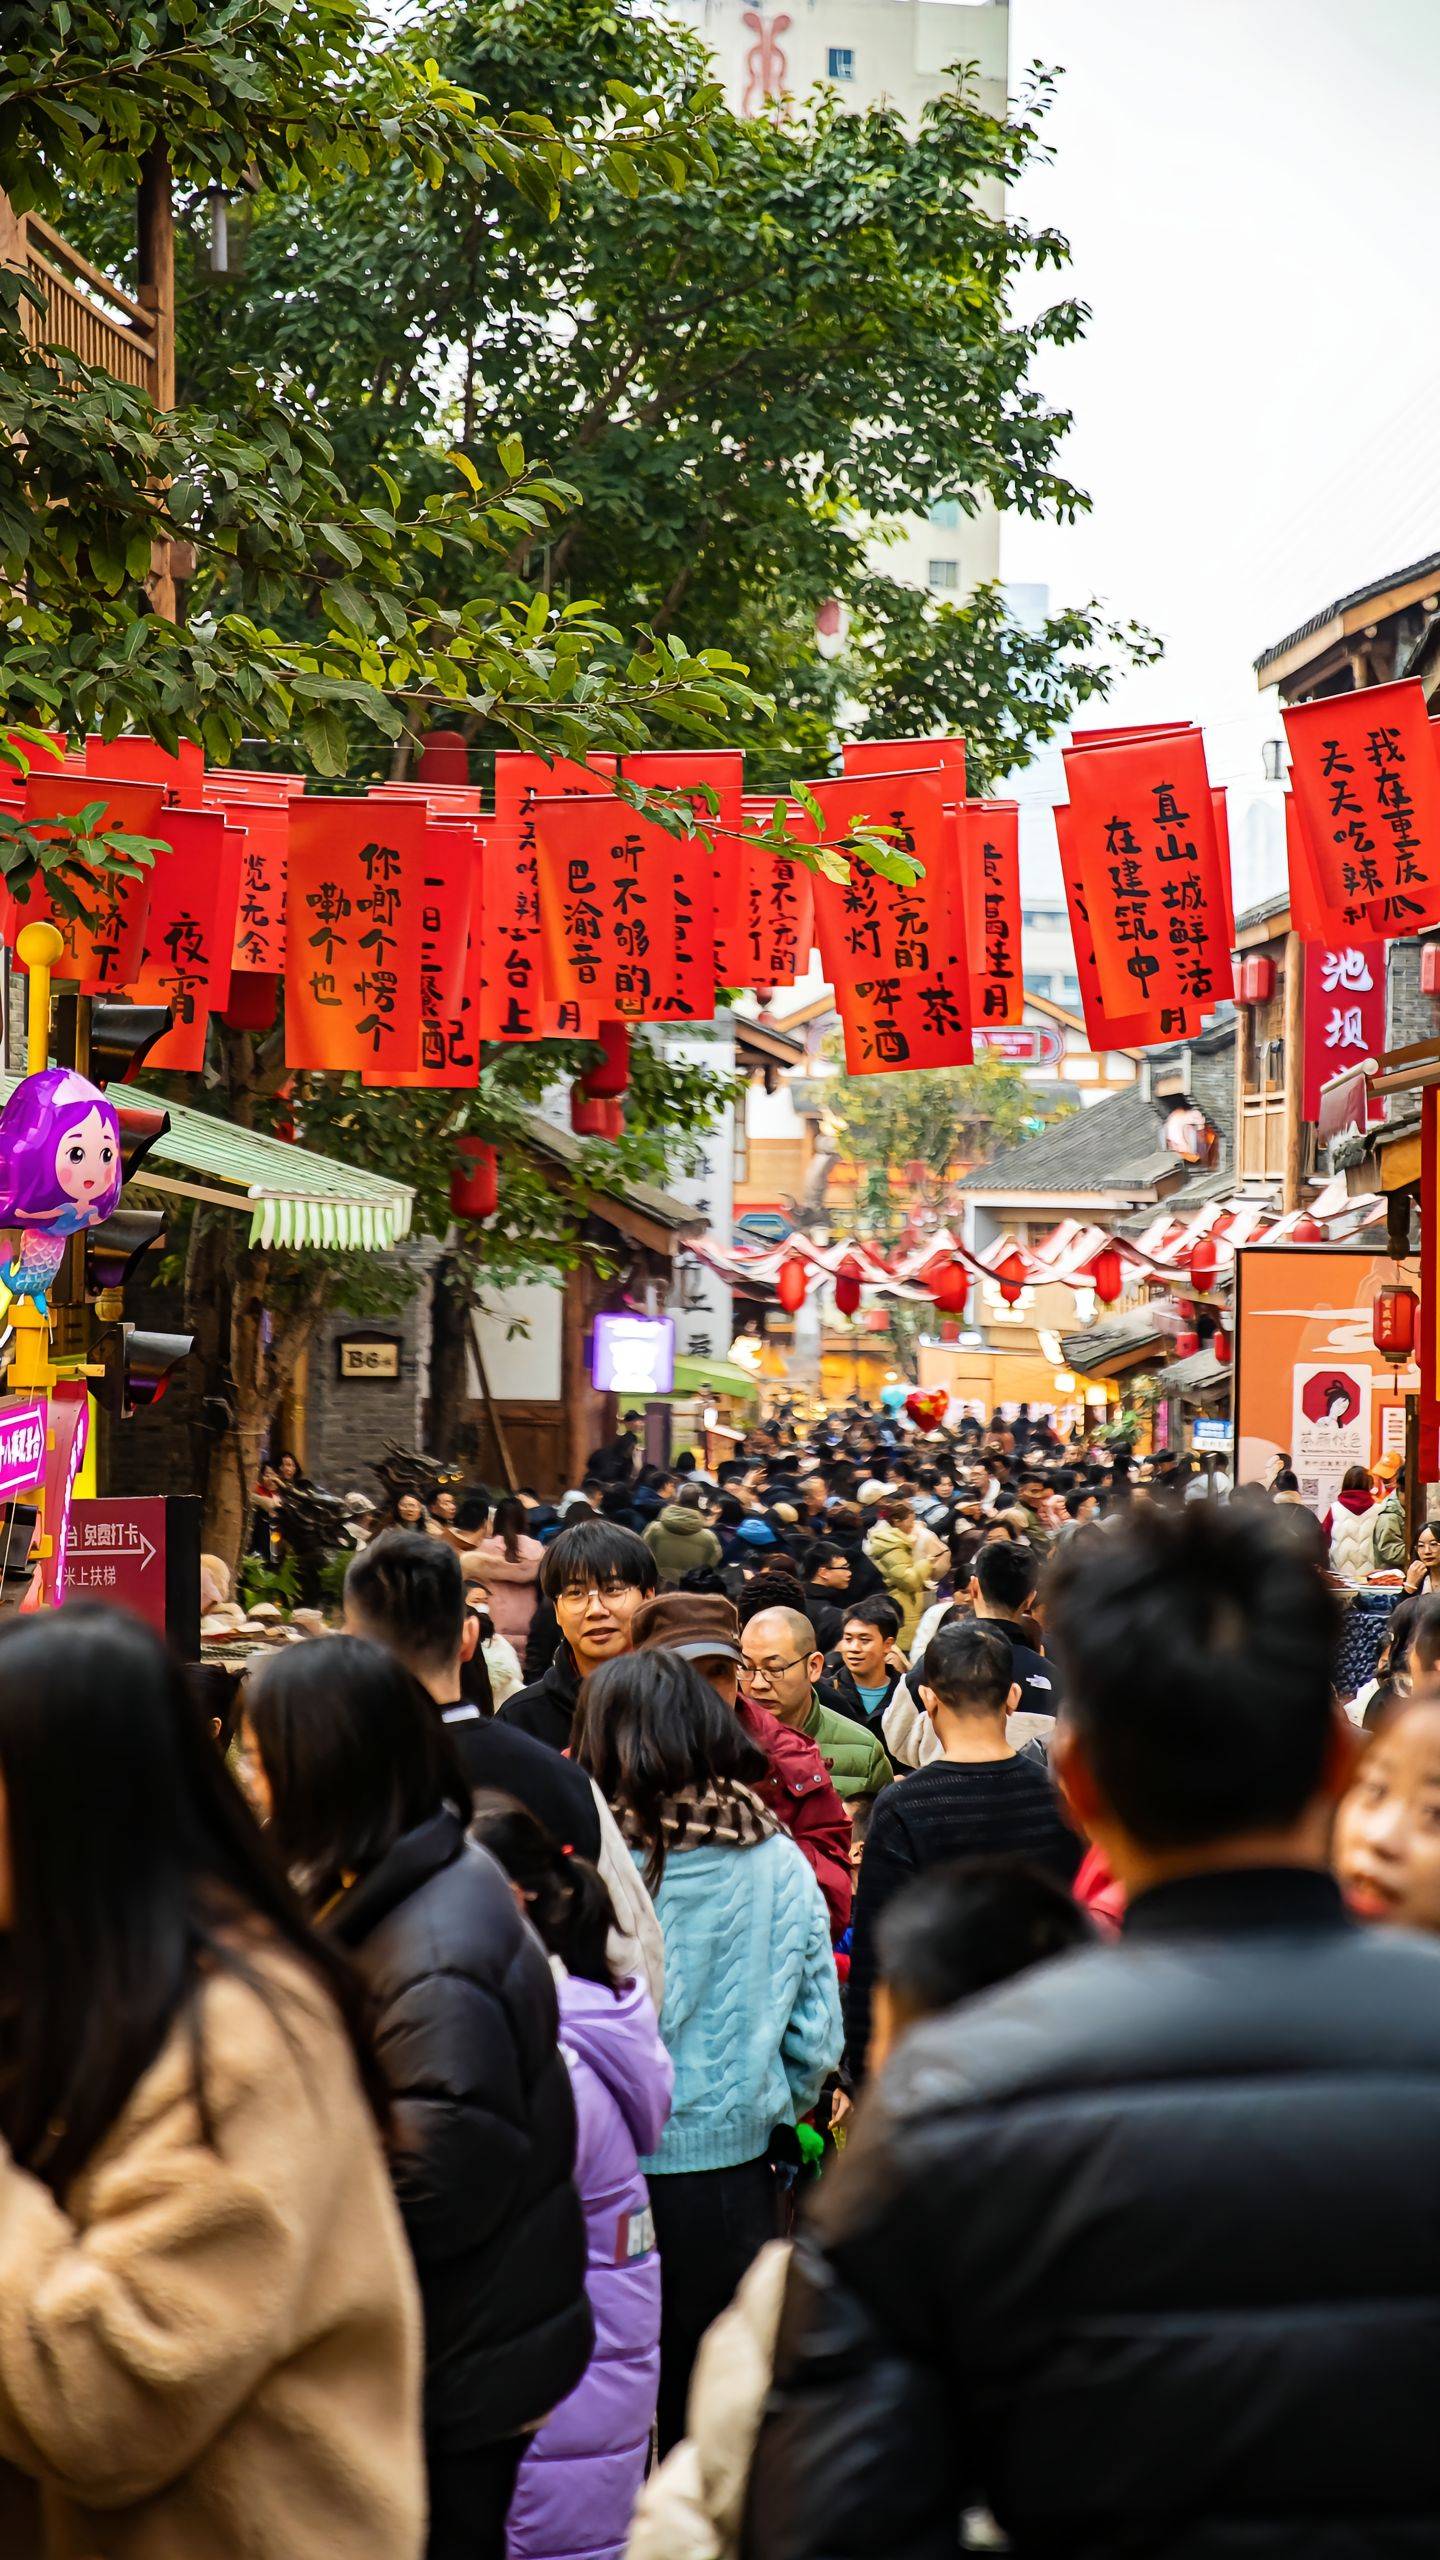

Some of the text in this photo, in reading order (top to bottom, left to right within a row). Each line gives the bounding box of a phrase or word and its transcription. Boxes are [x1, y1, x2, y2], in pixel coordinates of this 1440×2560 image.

[1320, 740, 1384, 897] 天天吃辣
[1364, 727, 1429, 886] 我在重庆
[158, 911, 209, 1024] 夜宵
[563, 859, 602, 985] 巴渝音
[610, 834, 651, 998] 听不够的
[888, 810, 929, 972] 看完的
[1104, 815, 1160, 999] 在建筑中
[1152, 781, 1213, 999] 真山城鲜活
[1320, 947, 1374, 1080] 池坝
[63, 1565, 117, 1587] 米上扶梯
[84, 1522, 139, 1547] 免费打卡
